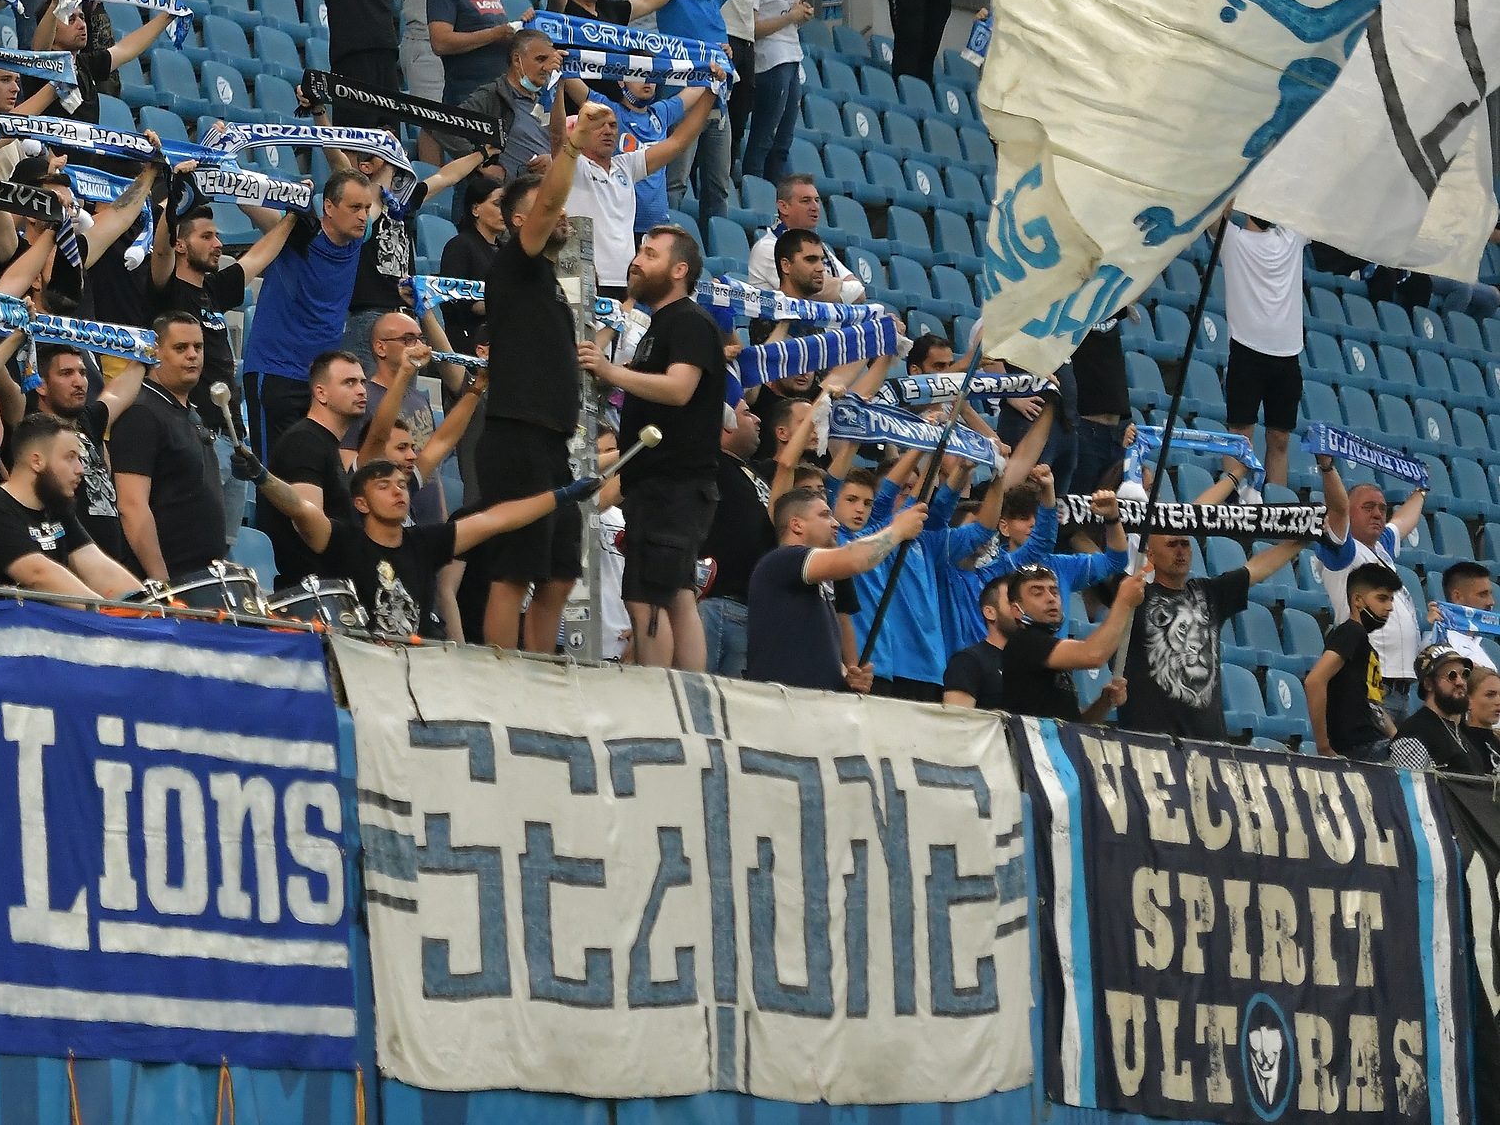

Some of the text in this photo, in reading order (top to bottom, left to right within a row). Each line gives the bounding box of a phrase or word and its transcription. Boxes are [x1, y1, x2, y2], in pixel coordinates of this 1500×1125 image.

[581, 22, 690, 61] CRAIOVA
[334, 83, 401, 112] ONOARE
[408, 103, 496, 137] FIDELITATE
[238, 123, 318, 140] FORZA
[197, 169, 312, 209] PELUZA NORD
[68, 318, 136, 349] NORD
[1201, 504, 1259, 532] CARE
[1260, 506, 1328, 537] UCIDE
[1079, 732, 1400, 868] VECHIUL
[2, 702, 349, 951] Lions
[1130, 865, 1384, 989] SPIRIT
